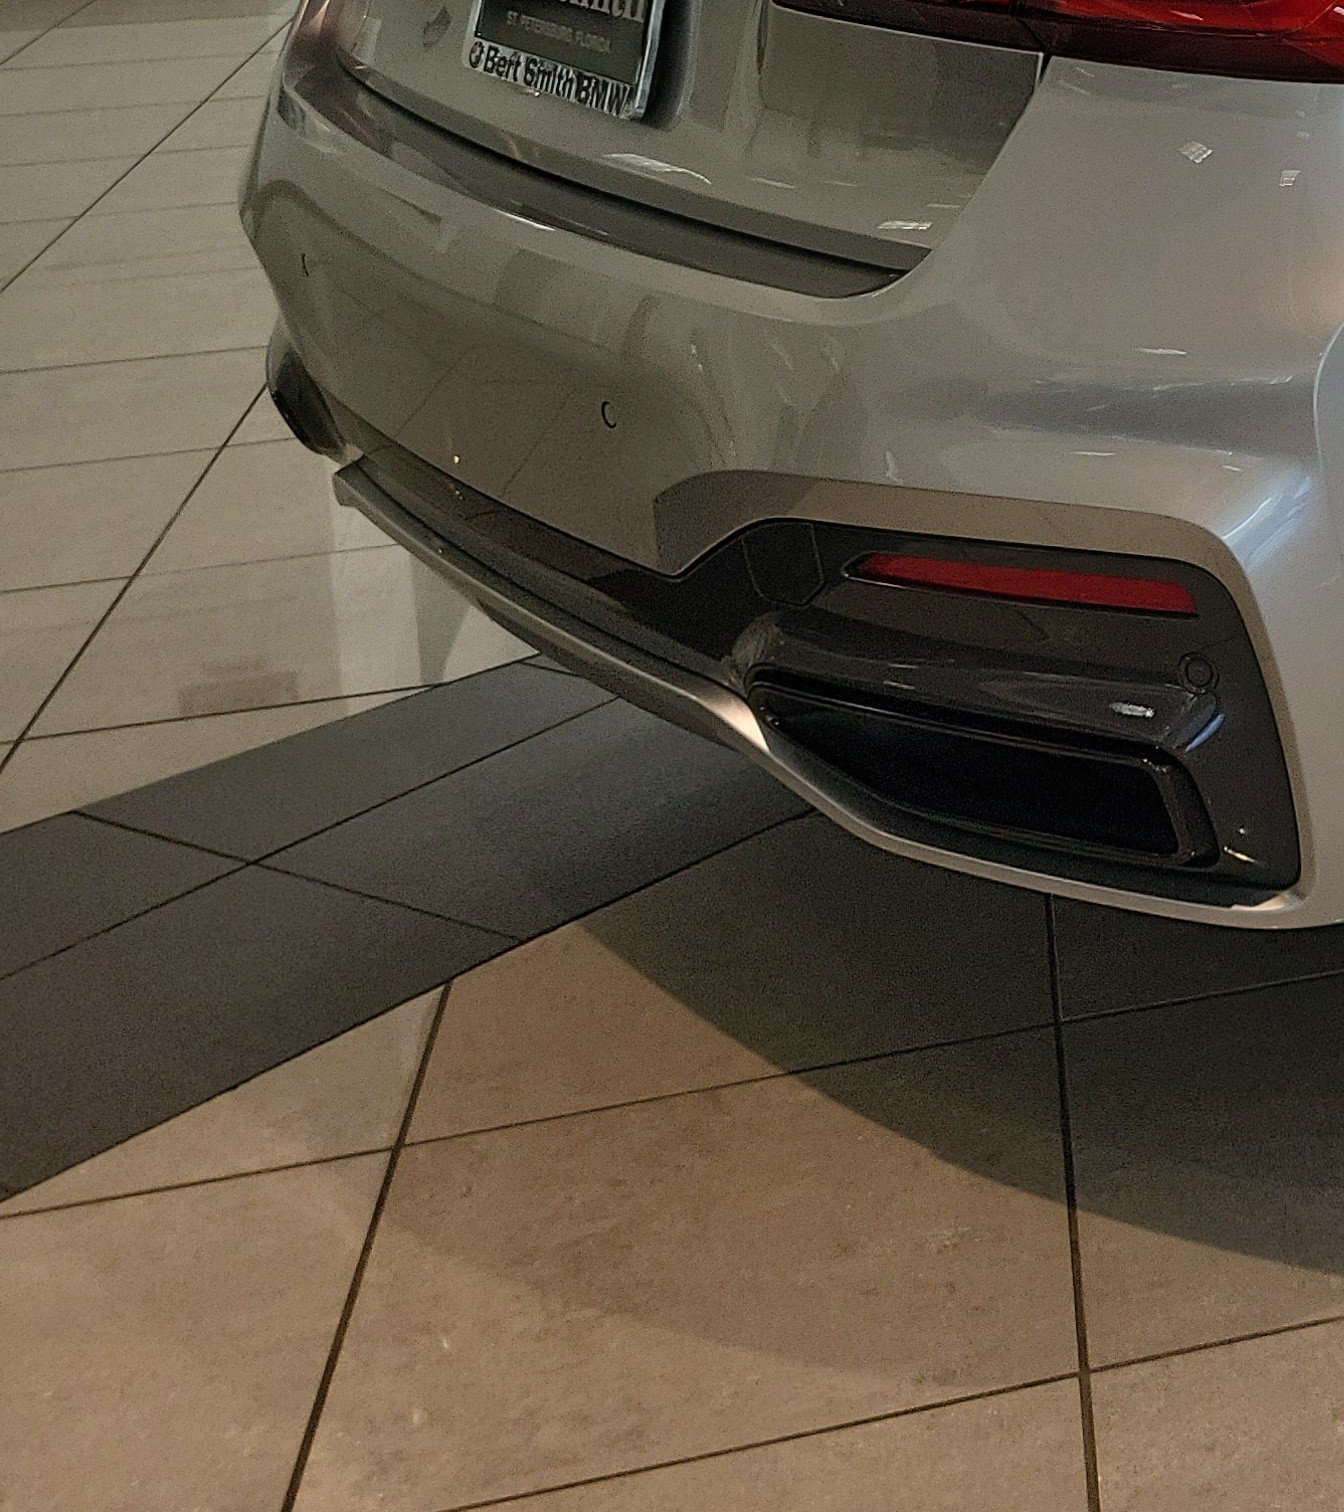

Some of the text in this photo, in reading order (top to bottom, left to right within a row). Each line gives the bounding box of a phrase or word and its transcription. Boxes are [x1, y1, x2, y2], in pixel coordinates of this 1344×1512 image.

[484, 45, 632, 116] Bert Smith BMW
